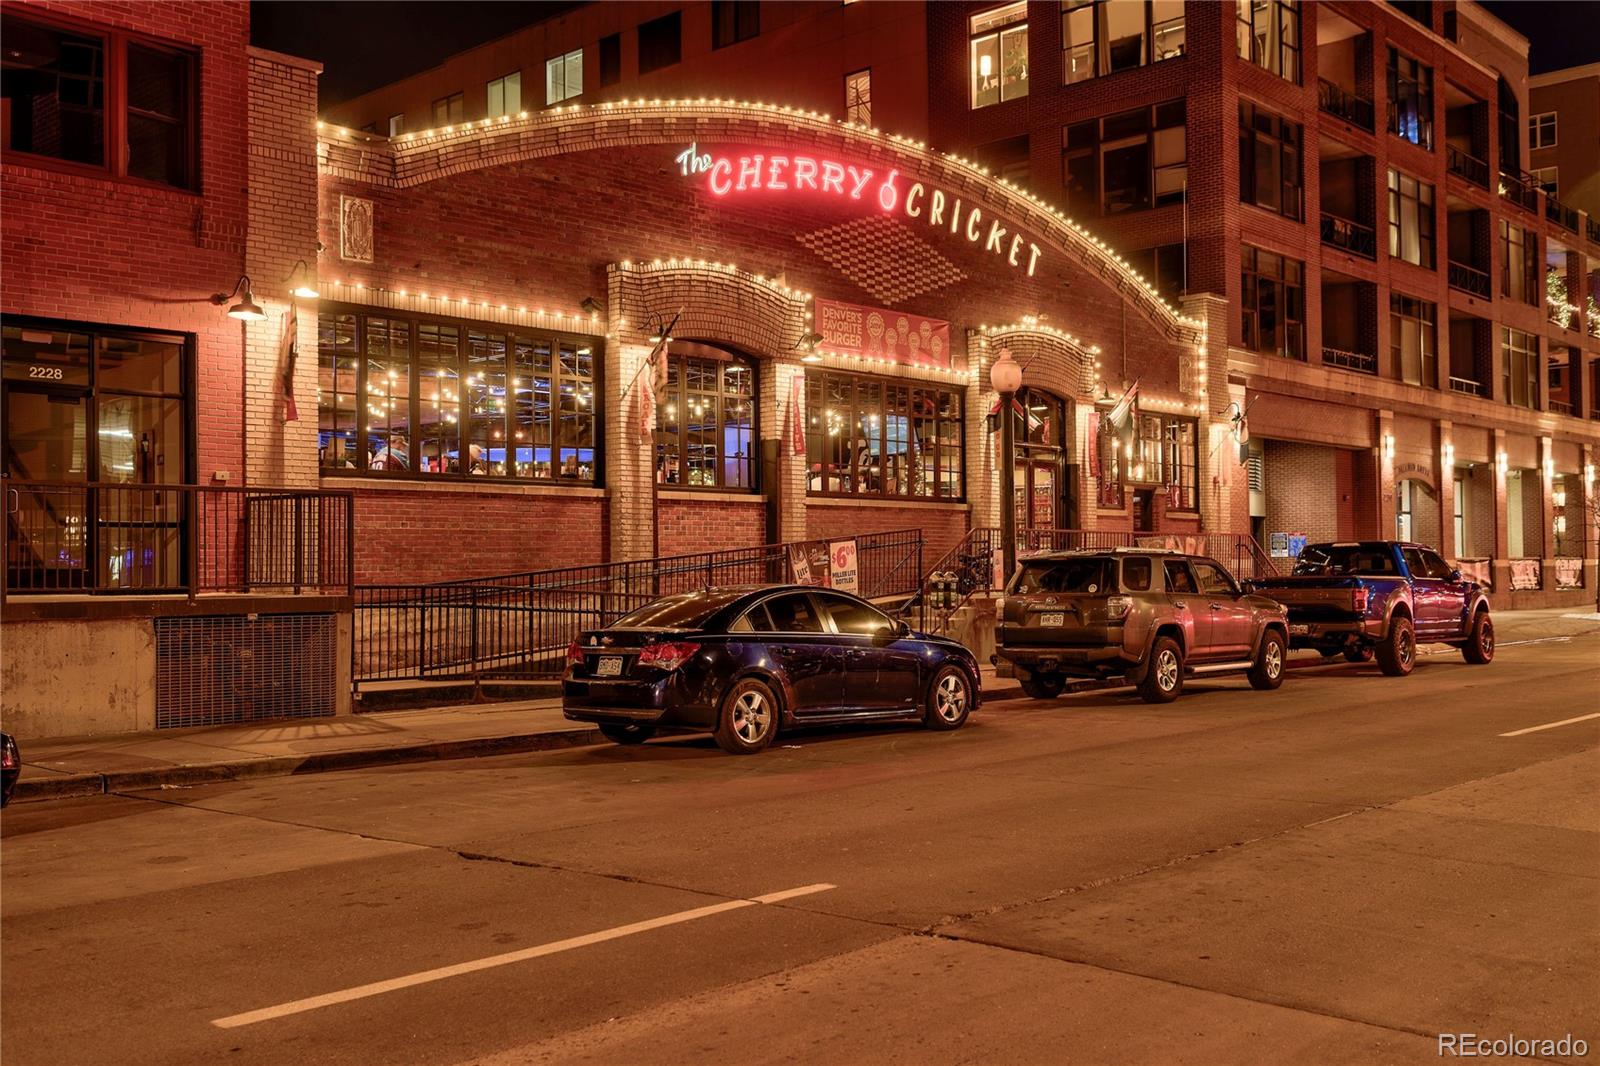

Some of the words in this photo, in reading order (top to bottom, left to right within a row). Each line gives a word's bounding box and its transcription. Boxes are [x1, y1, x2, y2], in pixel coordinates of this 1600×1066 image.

[675, 141, 713, 177] The
[710, 153, 874, 199] CHERRY
[905, 182, 1042, 277] CRICKET
[823, 306, 862, 324] DENVER'S
[823, 318, 862, 335] FAVORITE
[823, 330, 862, 348] BURGER
[29, 366, 63, 380] 2228
